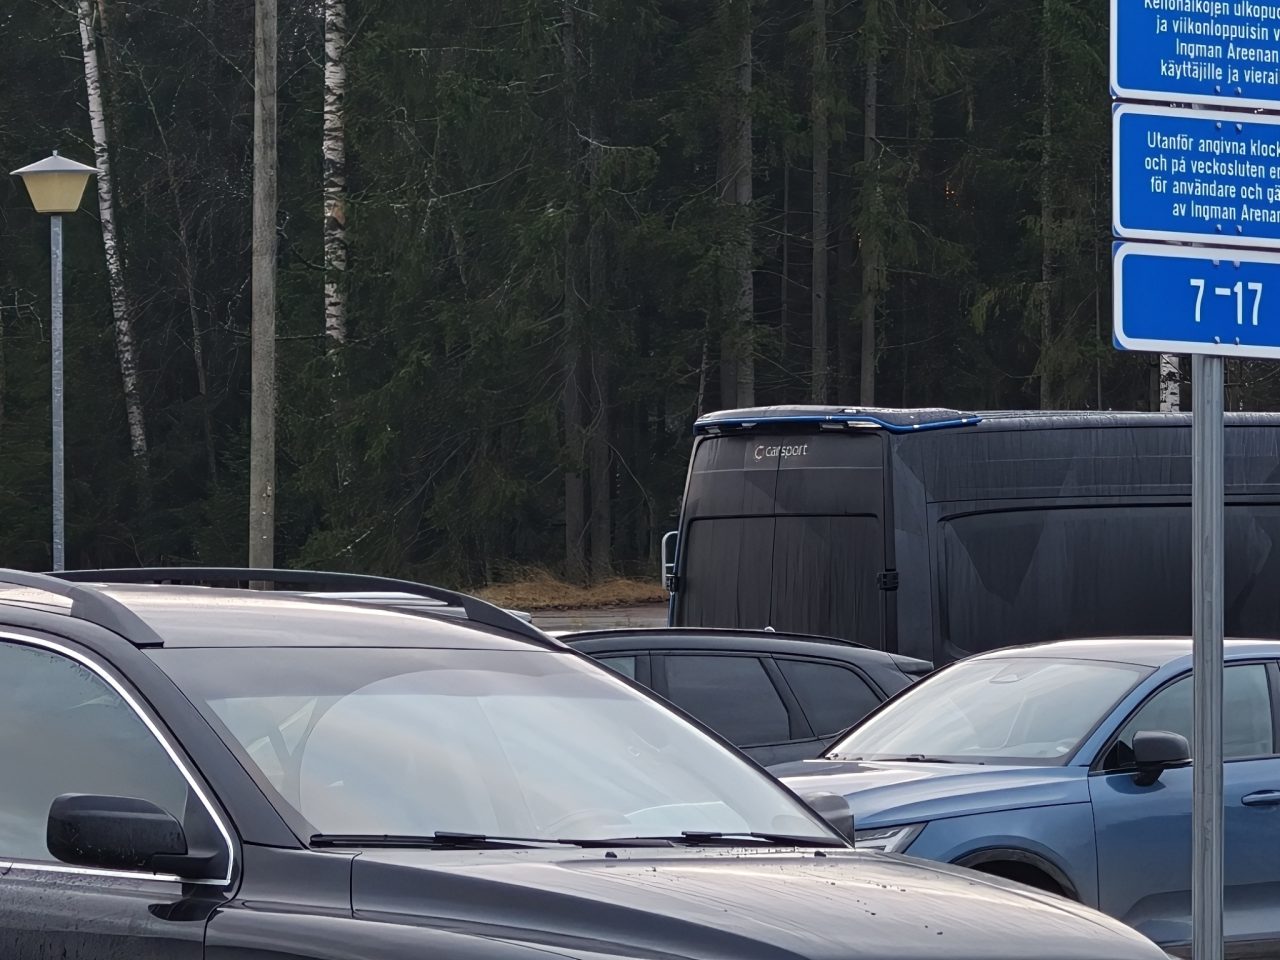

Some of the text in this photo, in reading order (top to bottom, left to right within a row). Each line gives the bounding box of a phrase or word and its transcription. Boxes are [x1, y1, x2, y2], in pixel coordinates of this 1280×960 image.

[1157, 15, 1167, 33] ja
[1173, 16, 1268, 41] viikonloppuisin
[1177, 39, 1278, 63] Ingman Areenan
[1161, 60, 1222, 81] käyttäjille
[1228, 69, 1238, 83] ja
[1148, 132, 1193, 150] Utanför
[1199, 138, 1245, 155] angivna
[1145, 155, 1166, 171] och
[1172, 157, 1185, 174] på
[1191, 159, 1264, 178] veckosluten
[1151, 176, 1167, 193] för
[1173, 179, 1236, 197] användare
[1241, 184, 1262, 199] och
[1173, 204, 1186, 216] av
[1192, 202, 1235, 220] Ingman
[1190, 279, 1262, 325] 7-17
[766, 444, 808, 458] carsport
